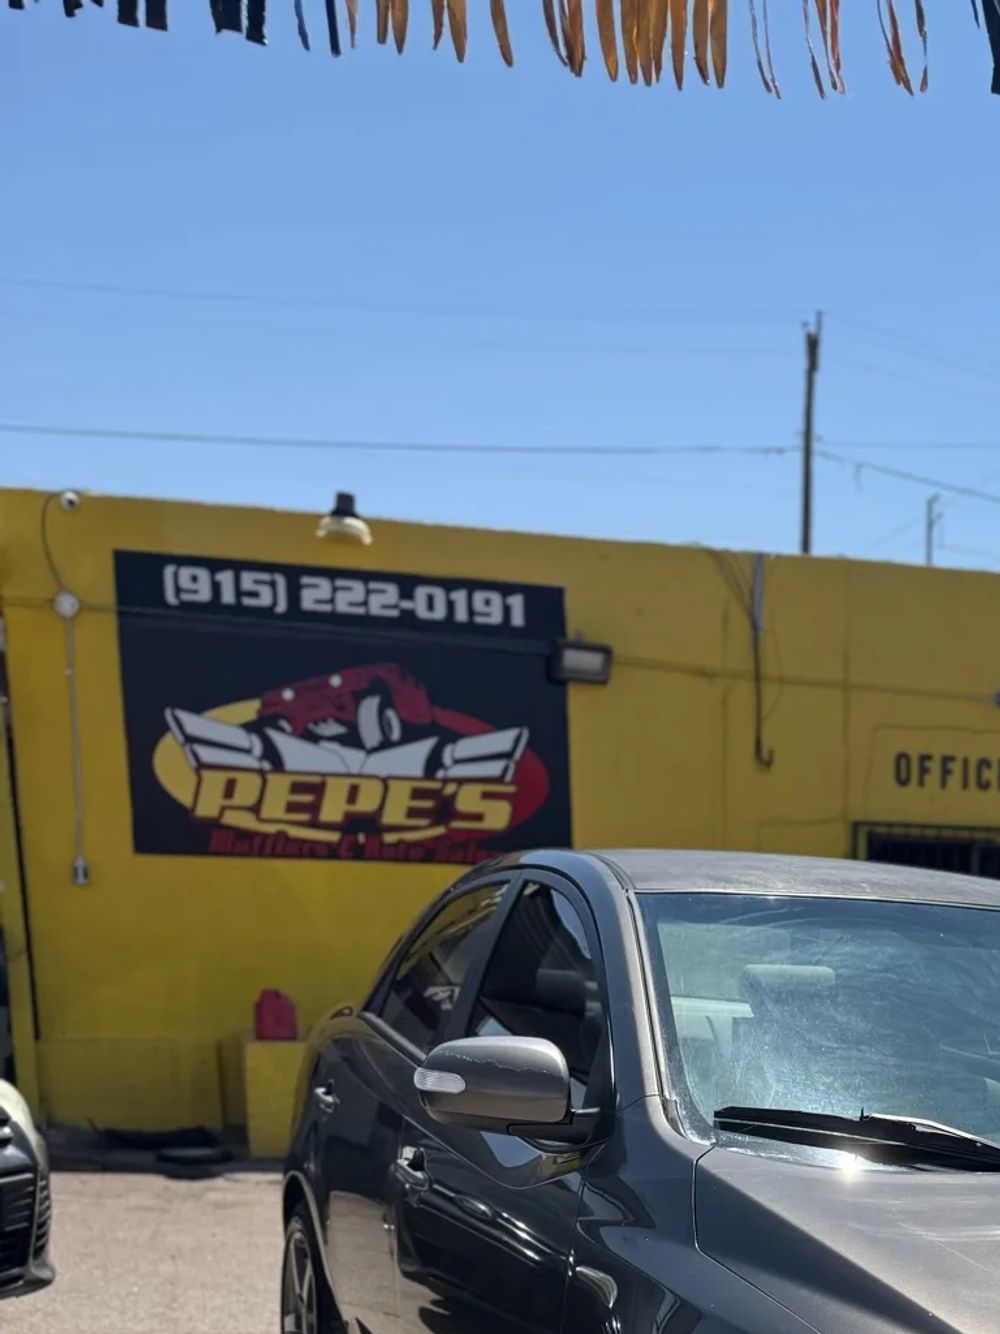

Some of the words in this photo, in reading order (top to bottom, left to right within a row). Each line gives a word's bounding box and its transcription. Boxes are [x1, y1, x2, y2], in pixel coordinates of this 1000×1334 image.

[163, 563, 289, 615] (915)
[299, 575, 526, 628] 222-0191
[194, 768, 518, 832] PEPE'S
